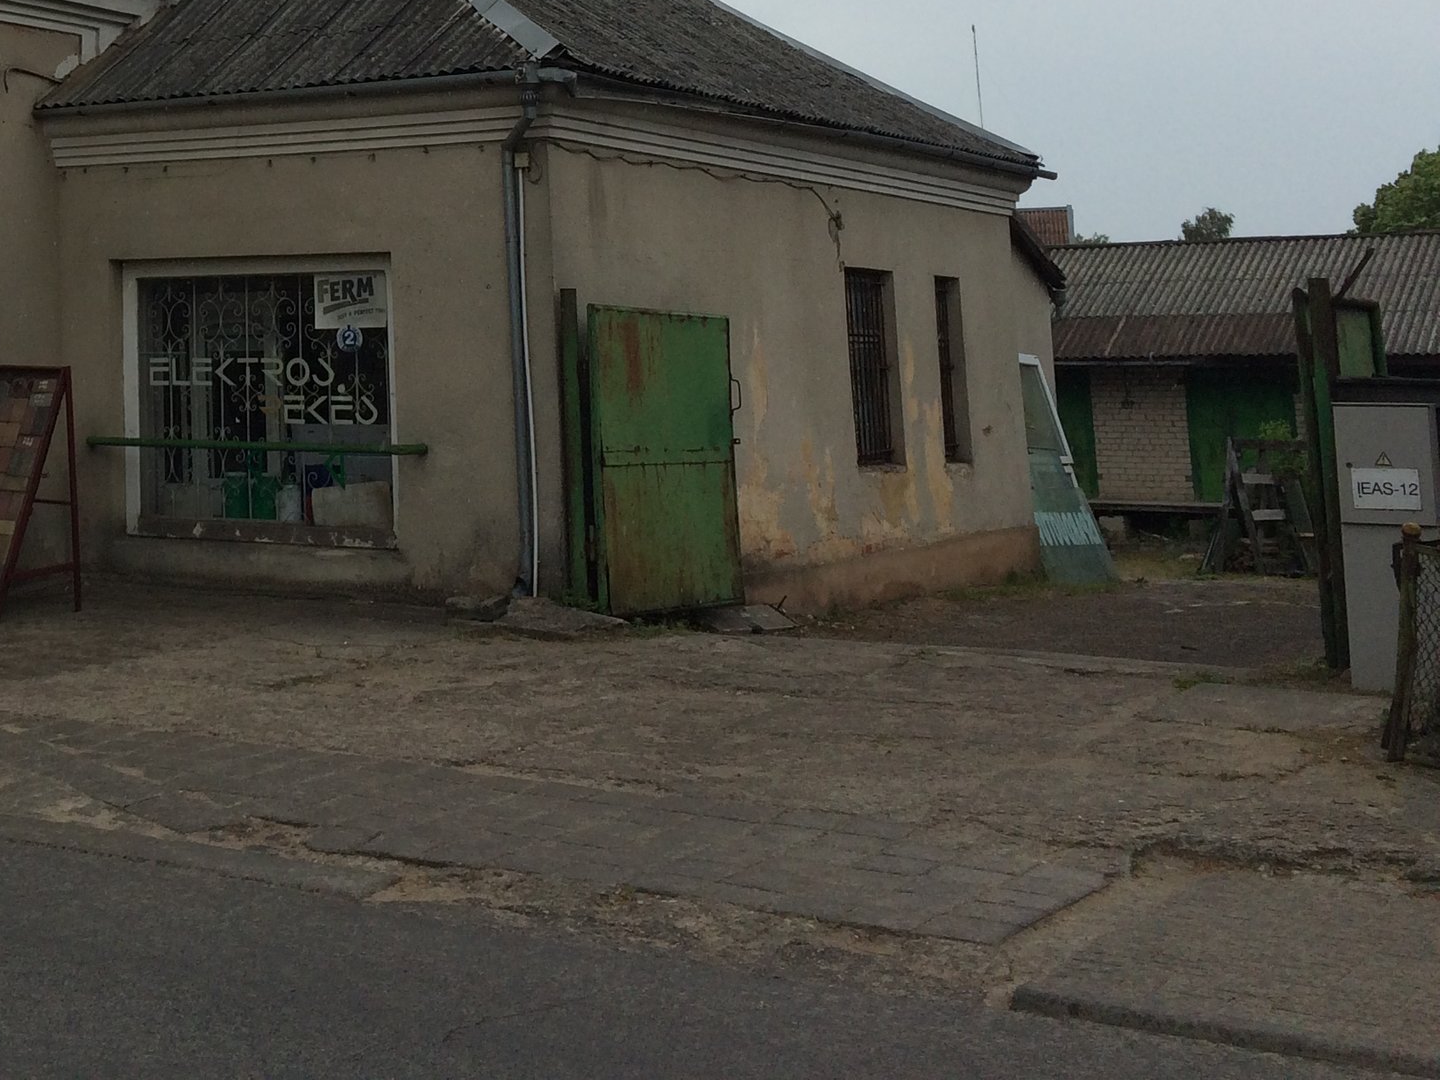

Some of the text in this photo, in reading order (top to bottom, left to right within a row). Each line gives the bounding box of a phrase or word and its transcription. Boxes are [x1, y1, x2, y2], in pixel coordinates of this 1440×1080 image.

[317, 276, 374, 303] FERM
[343, 331, 355, 345] 2
[149, 357, 336, 387] ELEKTROS
